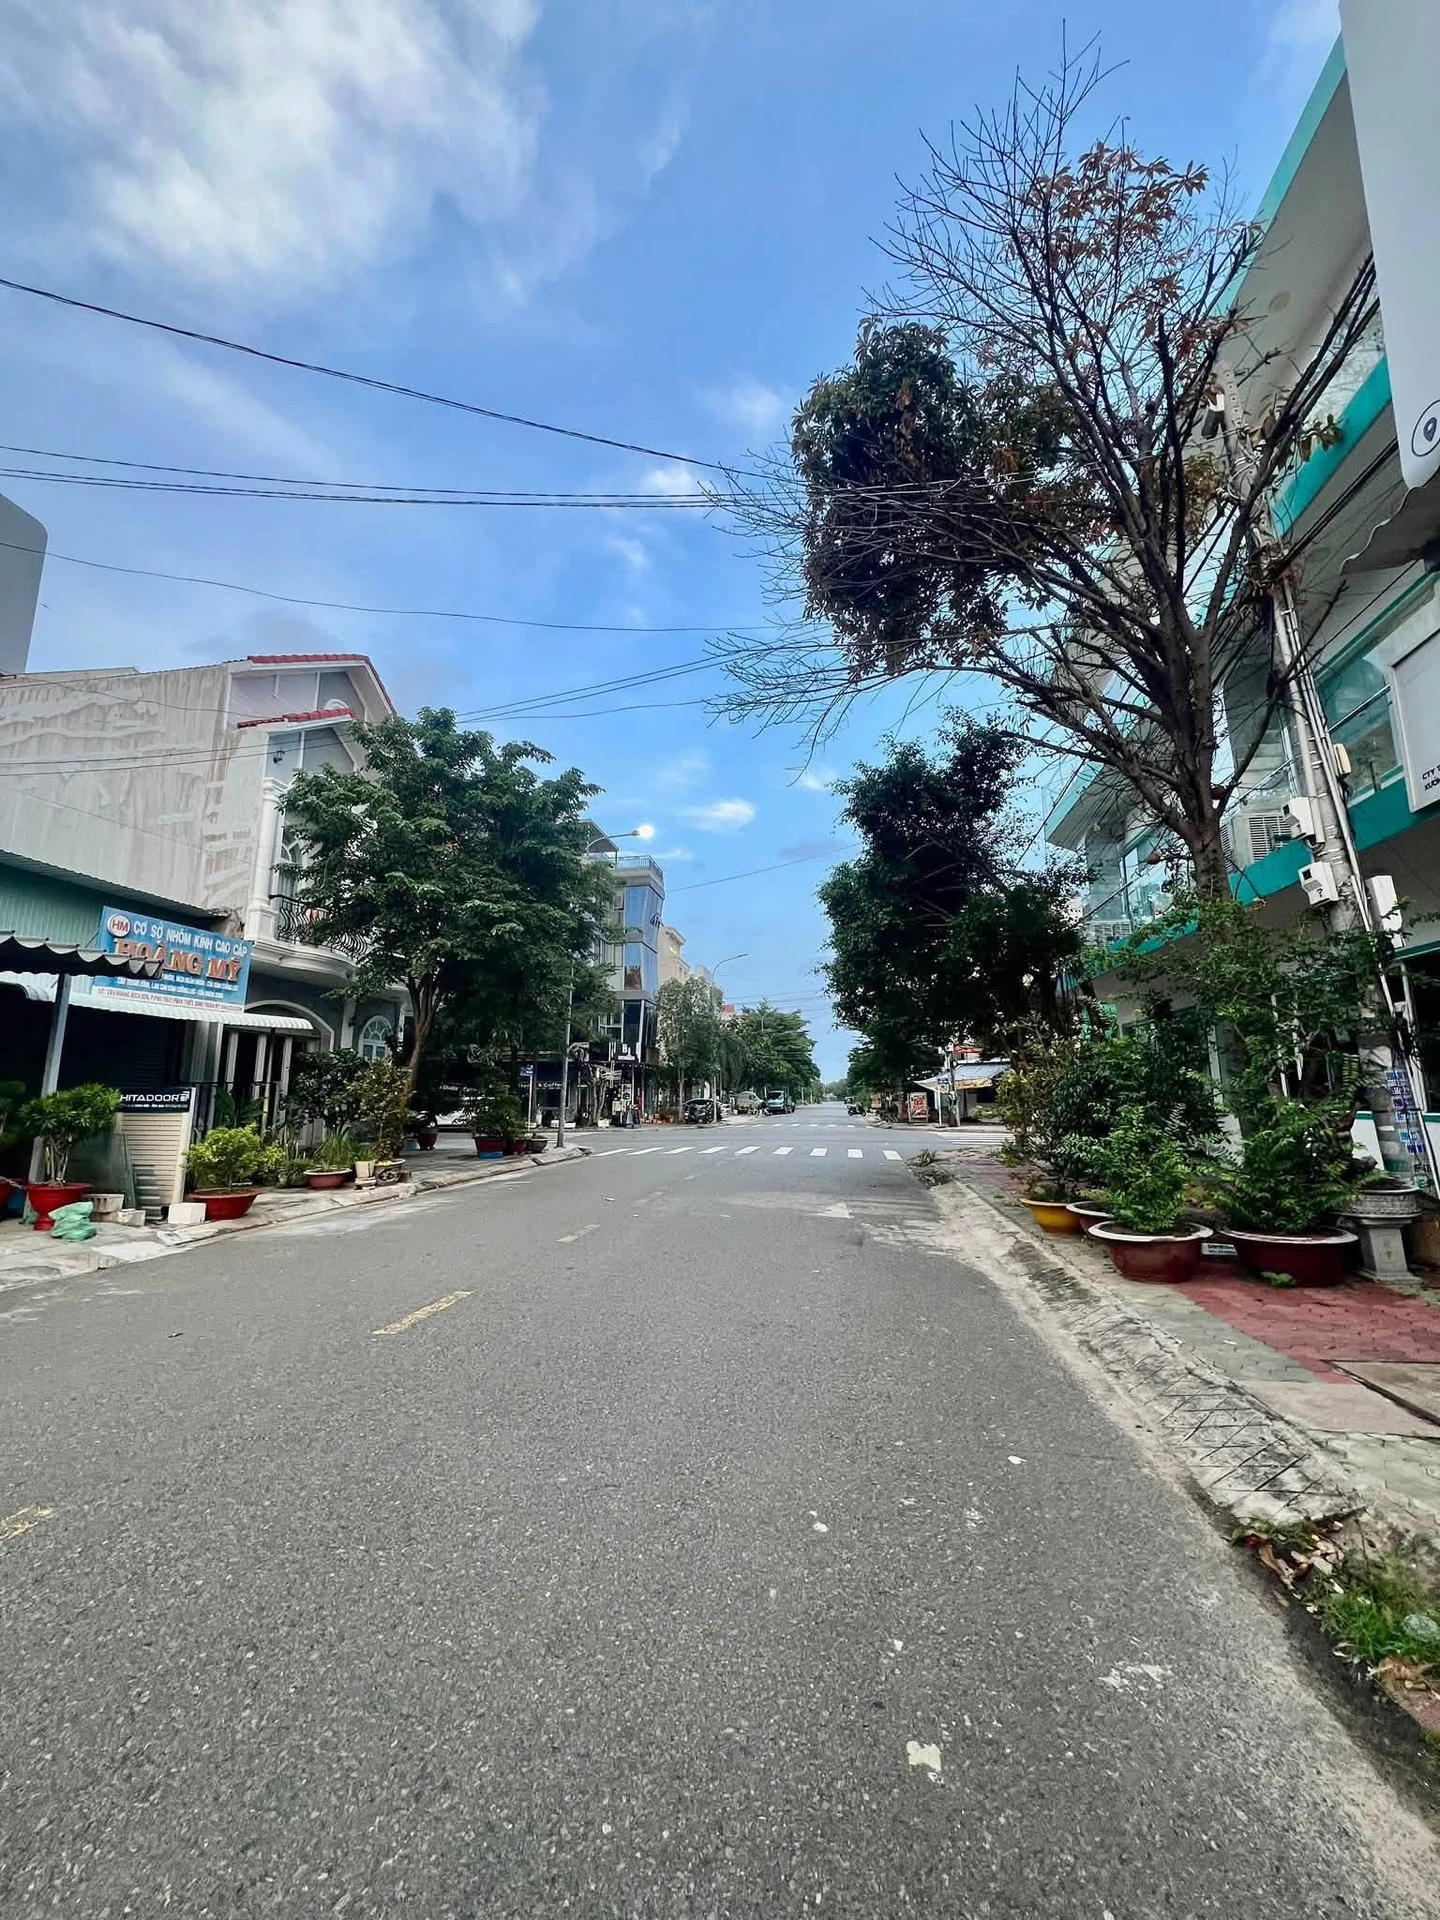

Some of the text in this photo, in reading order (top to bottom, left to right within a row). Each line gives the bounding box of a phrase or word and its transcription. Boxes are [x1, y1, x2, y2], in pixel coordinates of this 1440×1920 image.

[112, 919, 129, 932] HM
[133, 920, 248, 957] CƠ SỞ NHÔM KÍNH CAO CẤP
[113, 938, 242, 982] HOÀNG MỸ
[120, 1094, 180, 1102] HITADOOR
